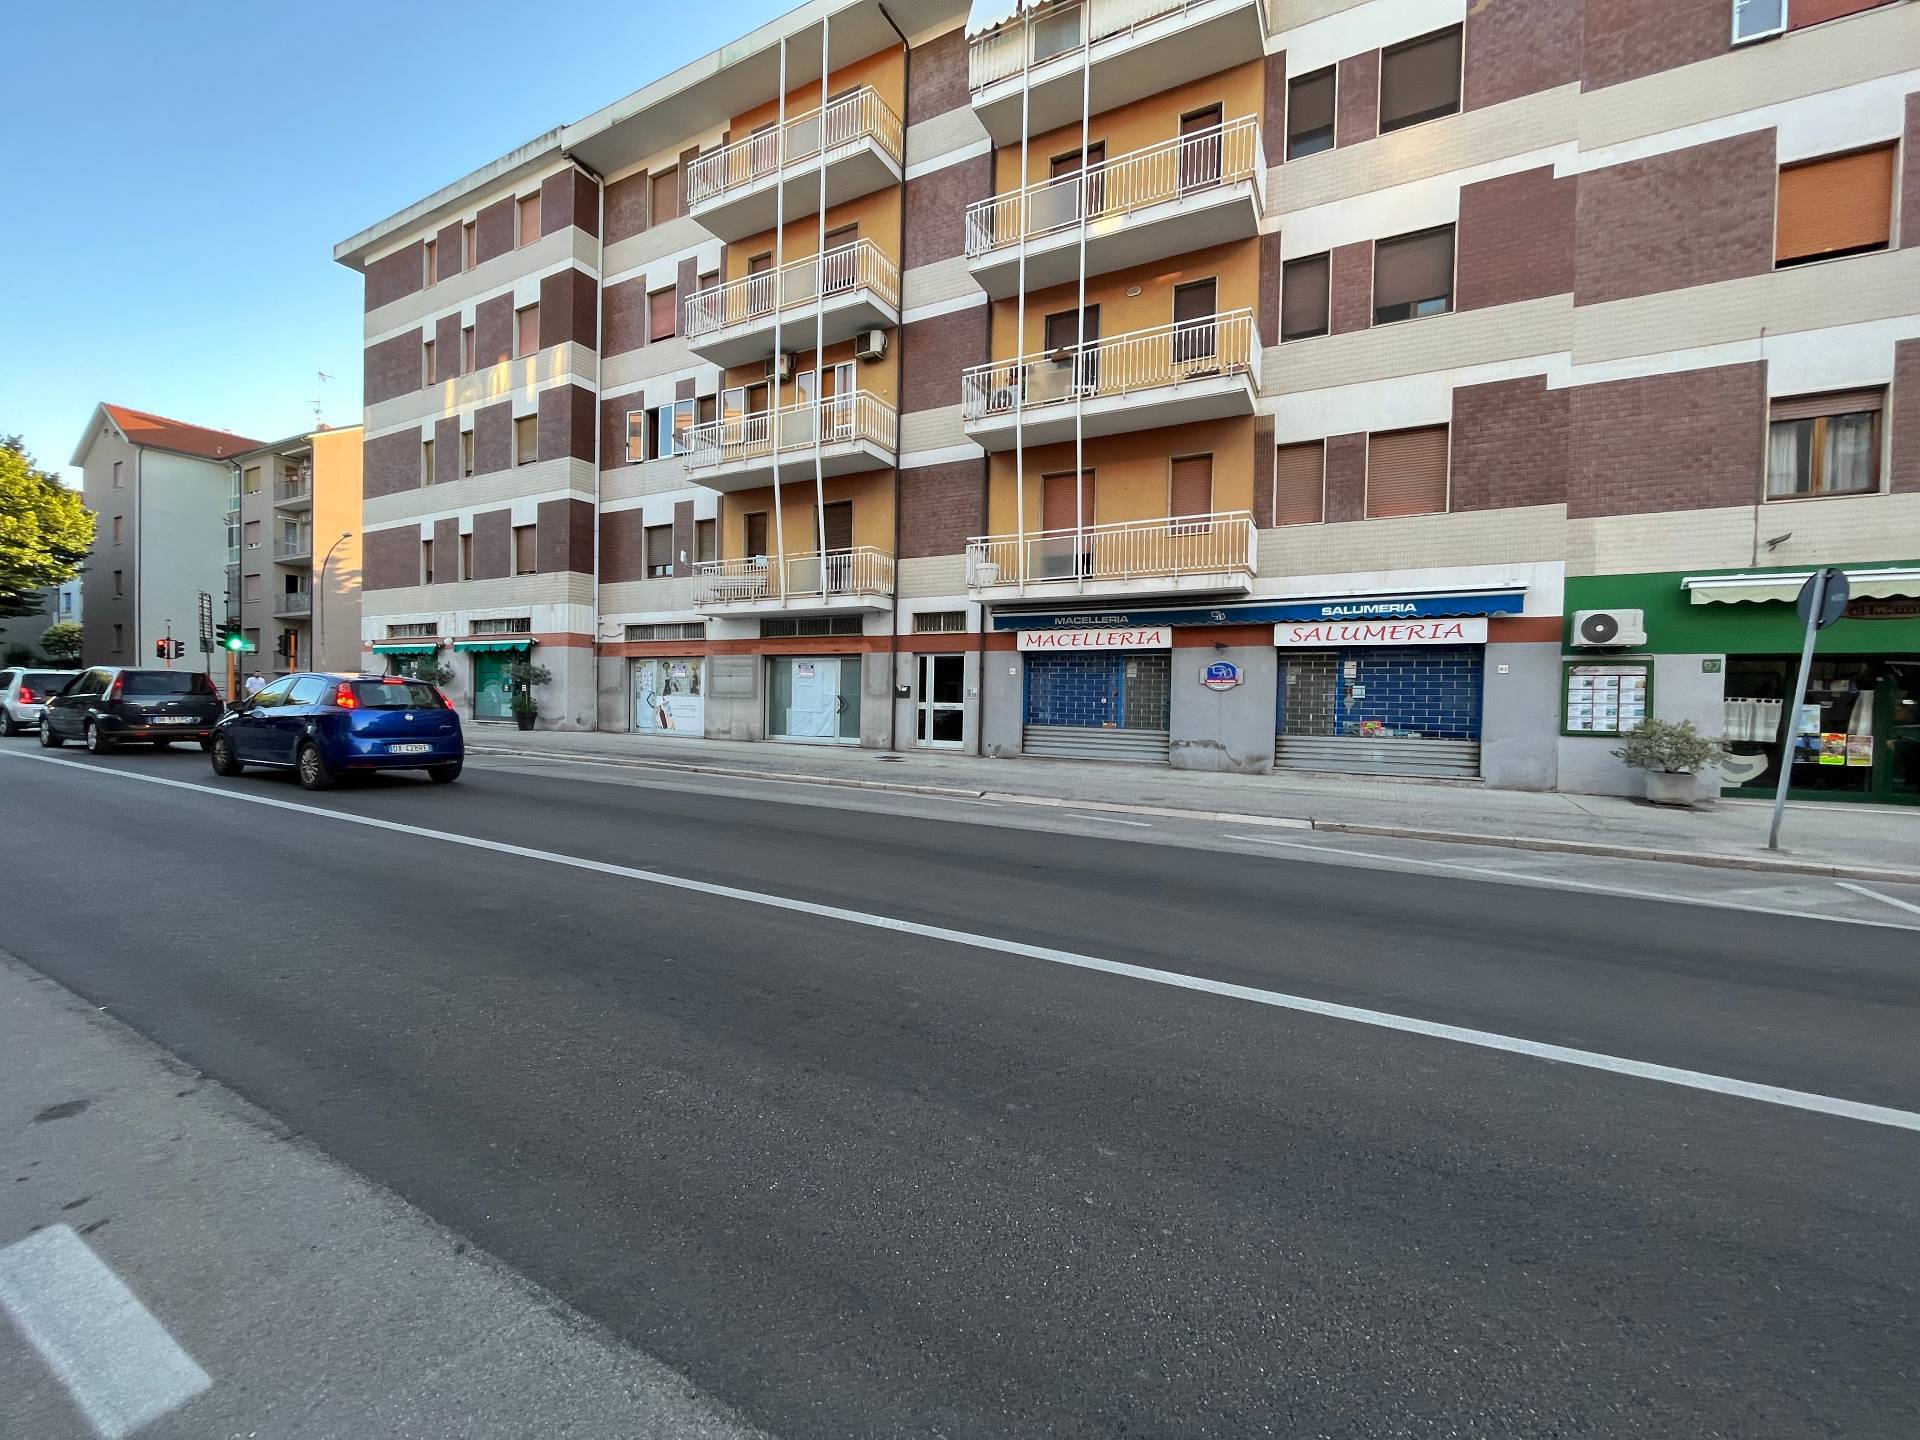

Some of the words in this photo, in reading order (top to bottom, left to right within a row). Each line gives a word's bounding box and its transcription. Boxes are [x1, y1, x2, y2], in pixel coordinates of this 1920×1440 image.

[1321, 603, 1417, 616] SALUMERIA
[1054, 615, 1129, 625] MACELLERIA
[1026, 631, 1161, 647] MACELLERIA
[1289, 623, 1464, 643] SALUMERIA
